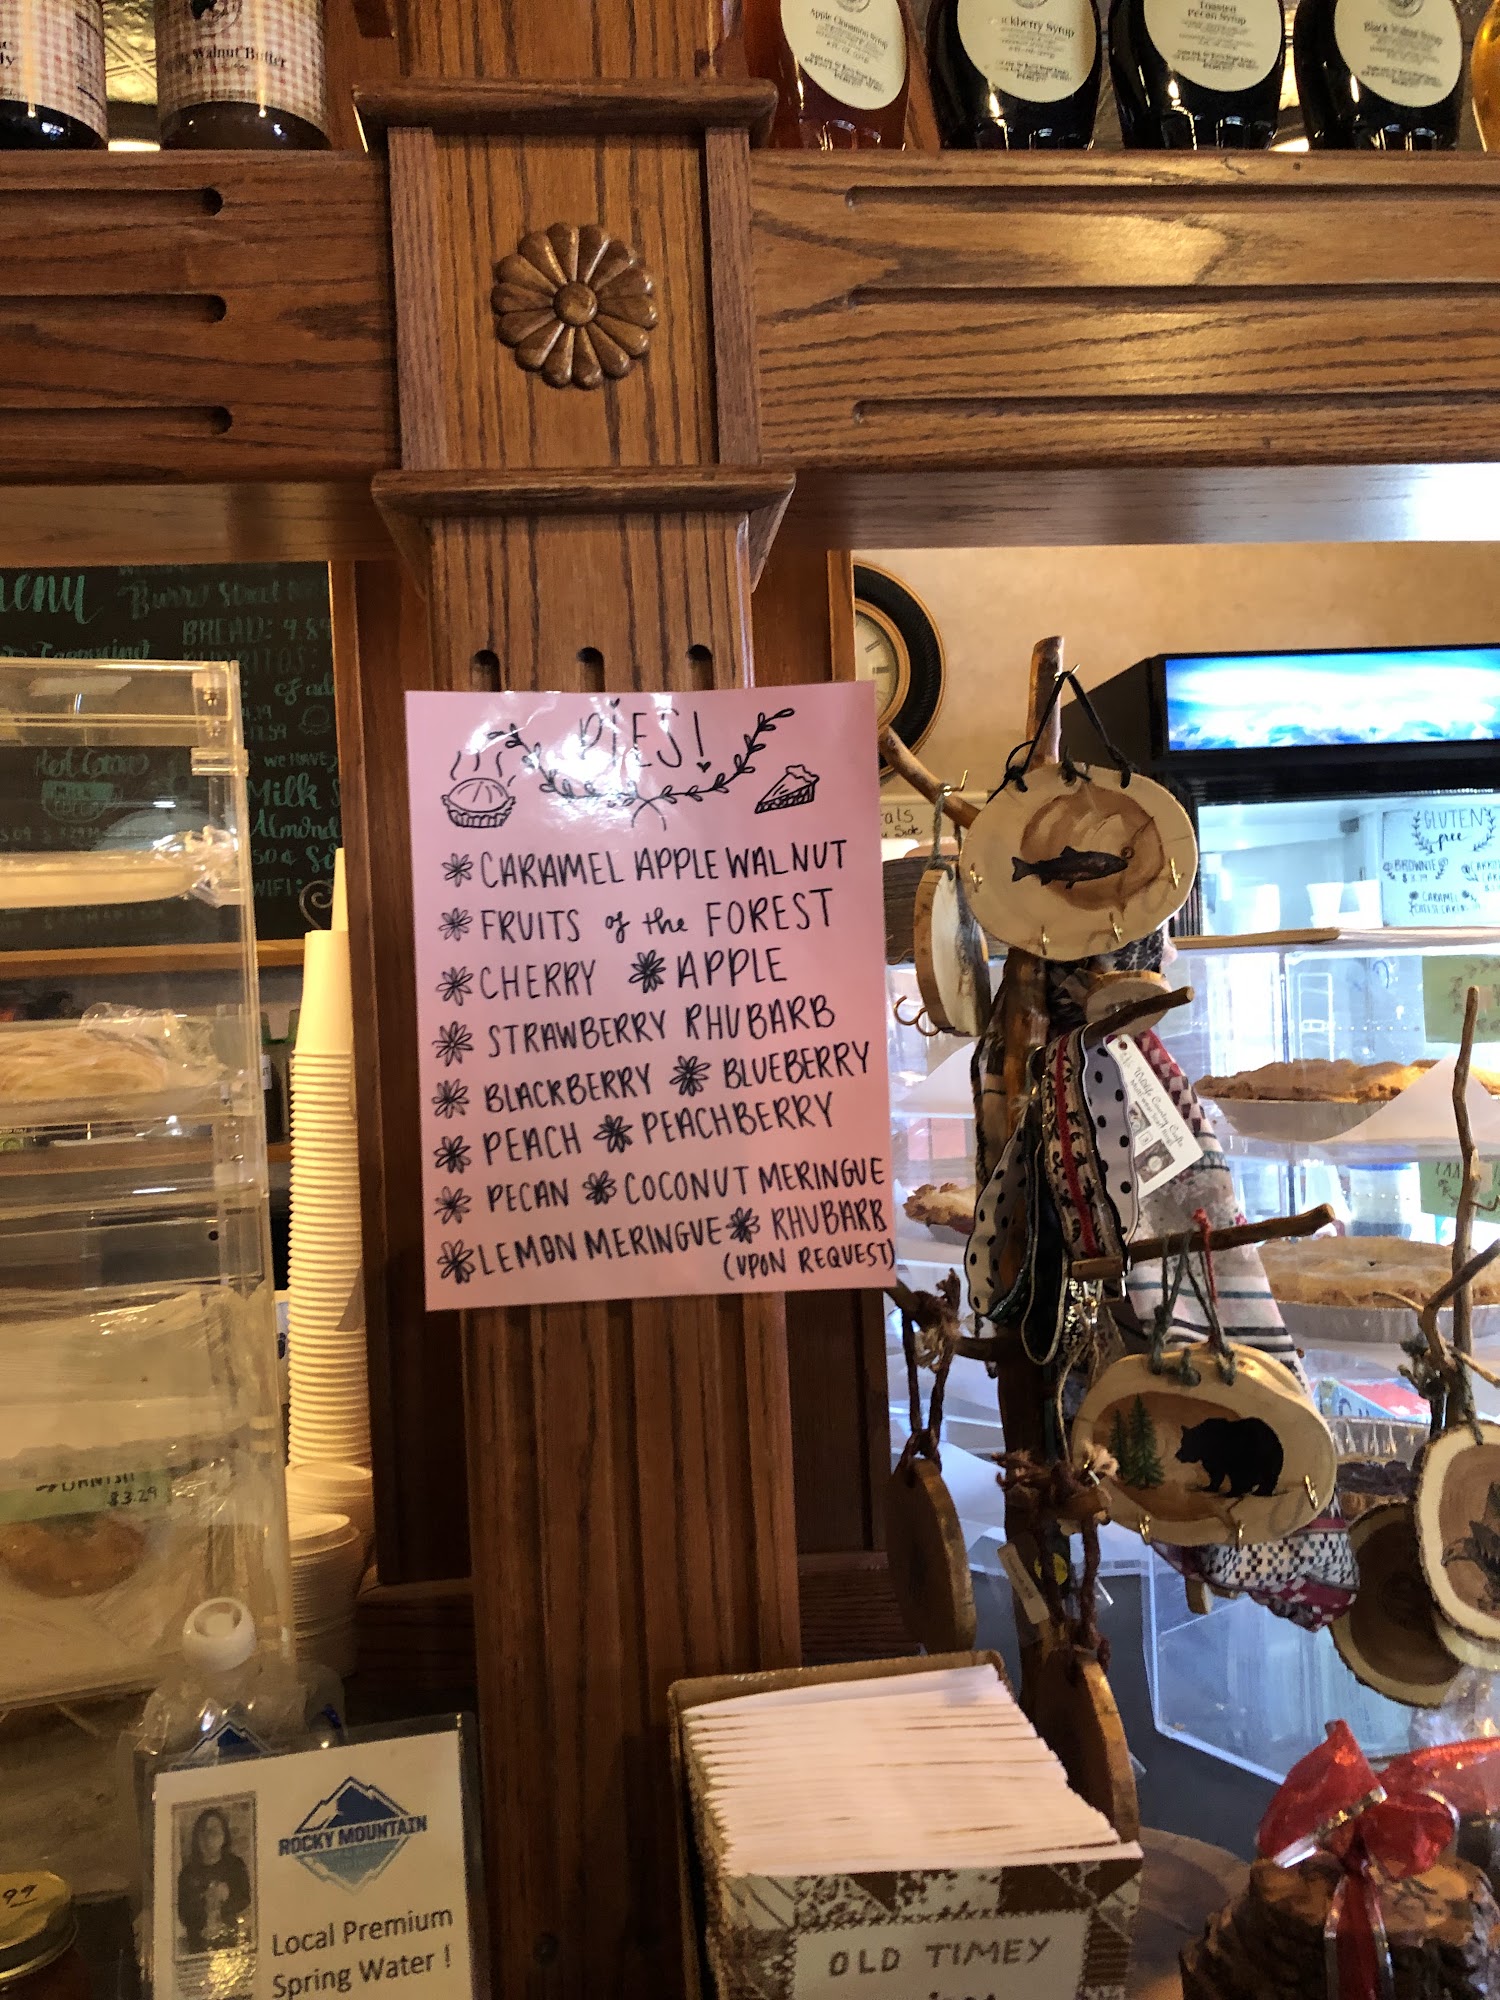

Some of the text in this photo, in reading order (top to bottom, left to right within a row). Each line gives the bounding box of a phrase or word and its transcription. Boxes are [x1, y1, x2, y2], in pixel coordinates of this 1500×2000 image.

[247, 772, 323, 810] Milk
[250, 807, 342, 840] Almond
[1423, 807, 1484, 830] GLUTEN
[480, 839, 847, 888] CARAMEL APPLE WALNUT
[1393, 858, 1437, 872] BROWNIE
[481, 888, 834, 943] FRUITS of the FOREST
[479, 947, 788, 1000] CHERRY APPLE
[487, 995, 835, 1059] STRAWBERRY RHUBARB
[484, 1041, 871, 1114] BLACKBERRY BLUEBERRY
[483, 1091, 834, 1166] PEACH PEACHBERRY
[486, 1157, 885, 1213] PECAN COCONUT MERINGUE
[475, 1198, 888, 1276] LEMON MERINGUE RHUBARB
[723, 1238, 896, 1281] (UPON REQUEST)
[107, 1486, 158, 1507] $3.29
[278, 1815, 428, 1857] ROCKY MOUNTAIN
[271, 1908, 454, 1957] Local Premium
[828, 1936, 1051, 1977] OLD TIMEY
[272, 1968, 352, 2000] Spring
[358, 1952, 435, 1983] Water
